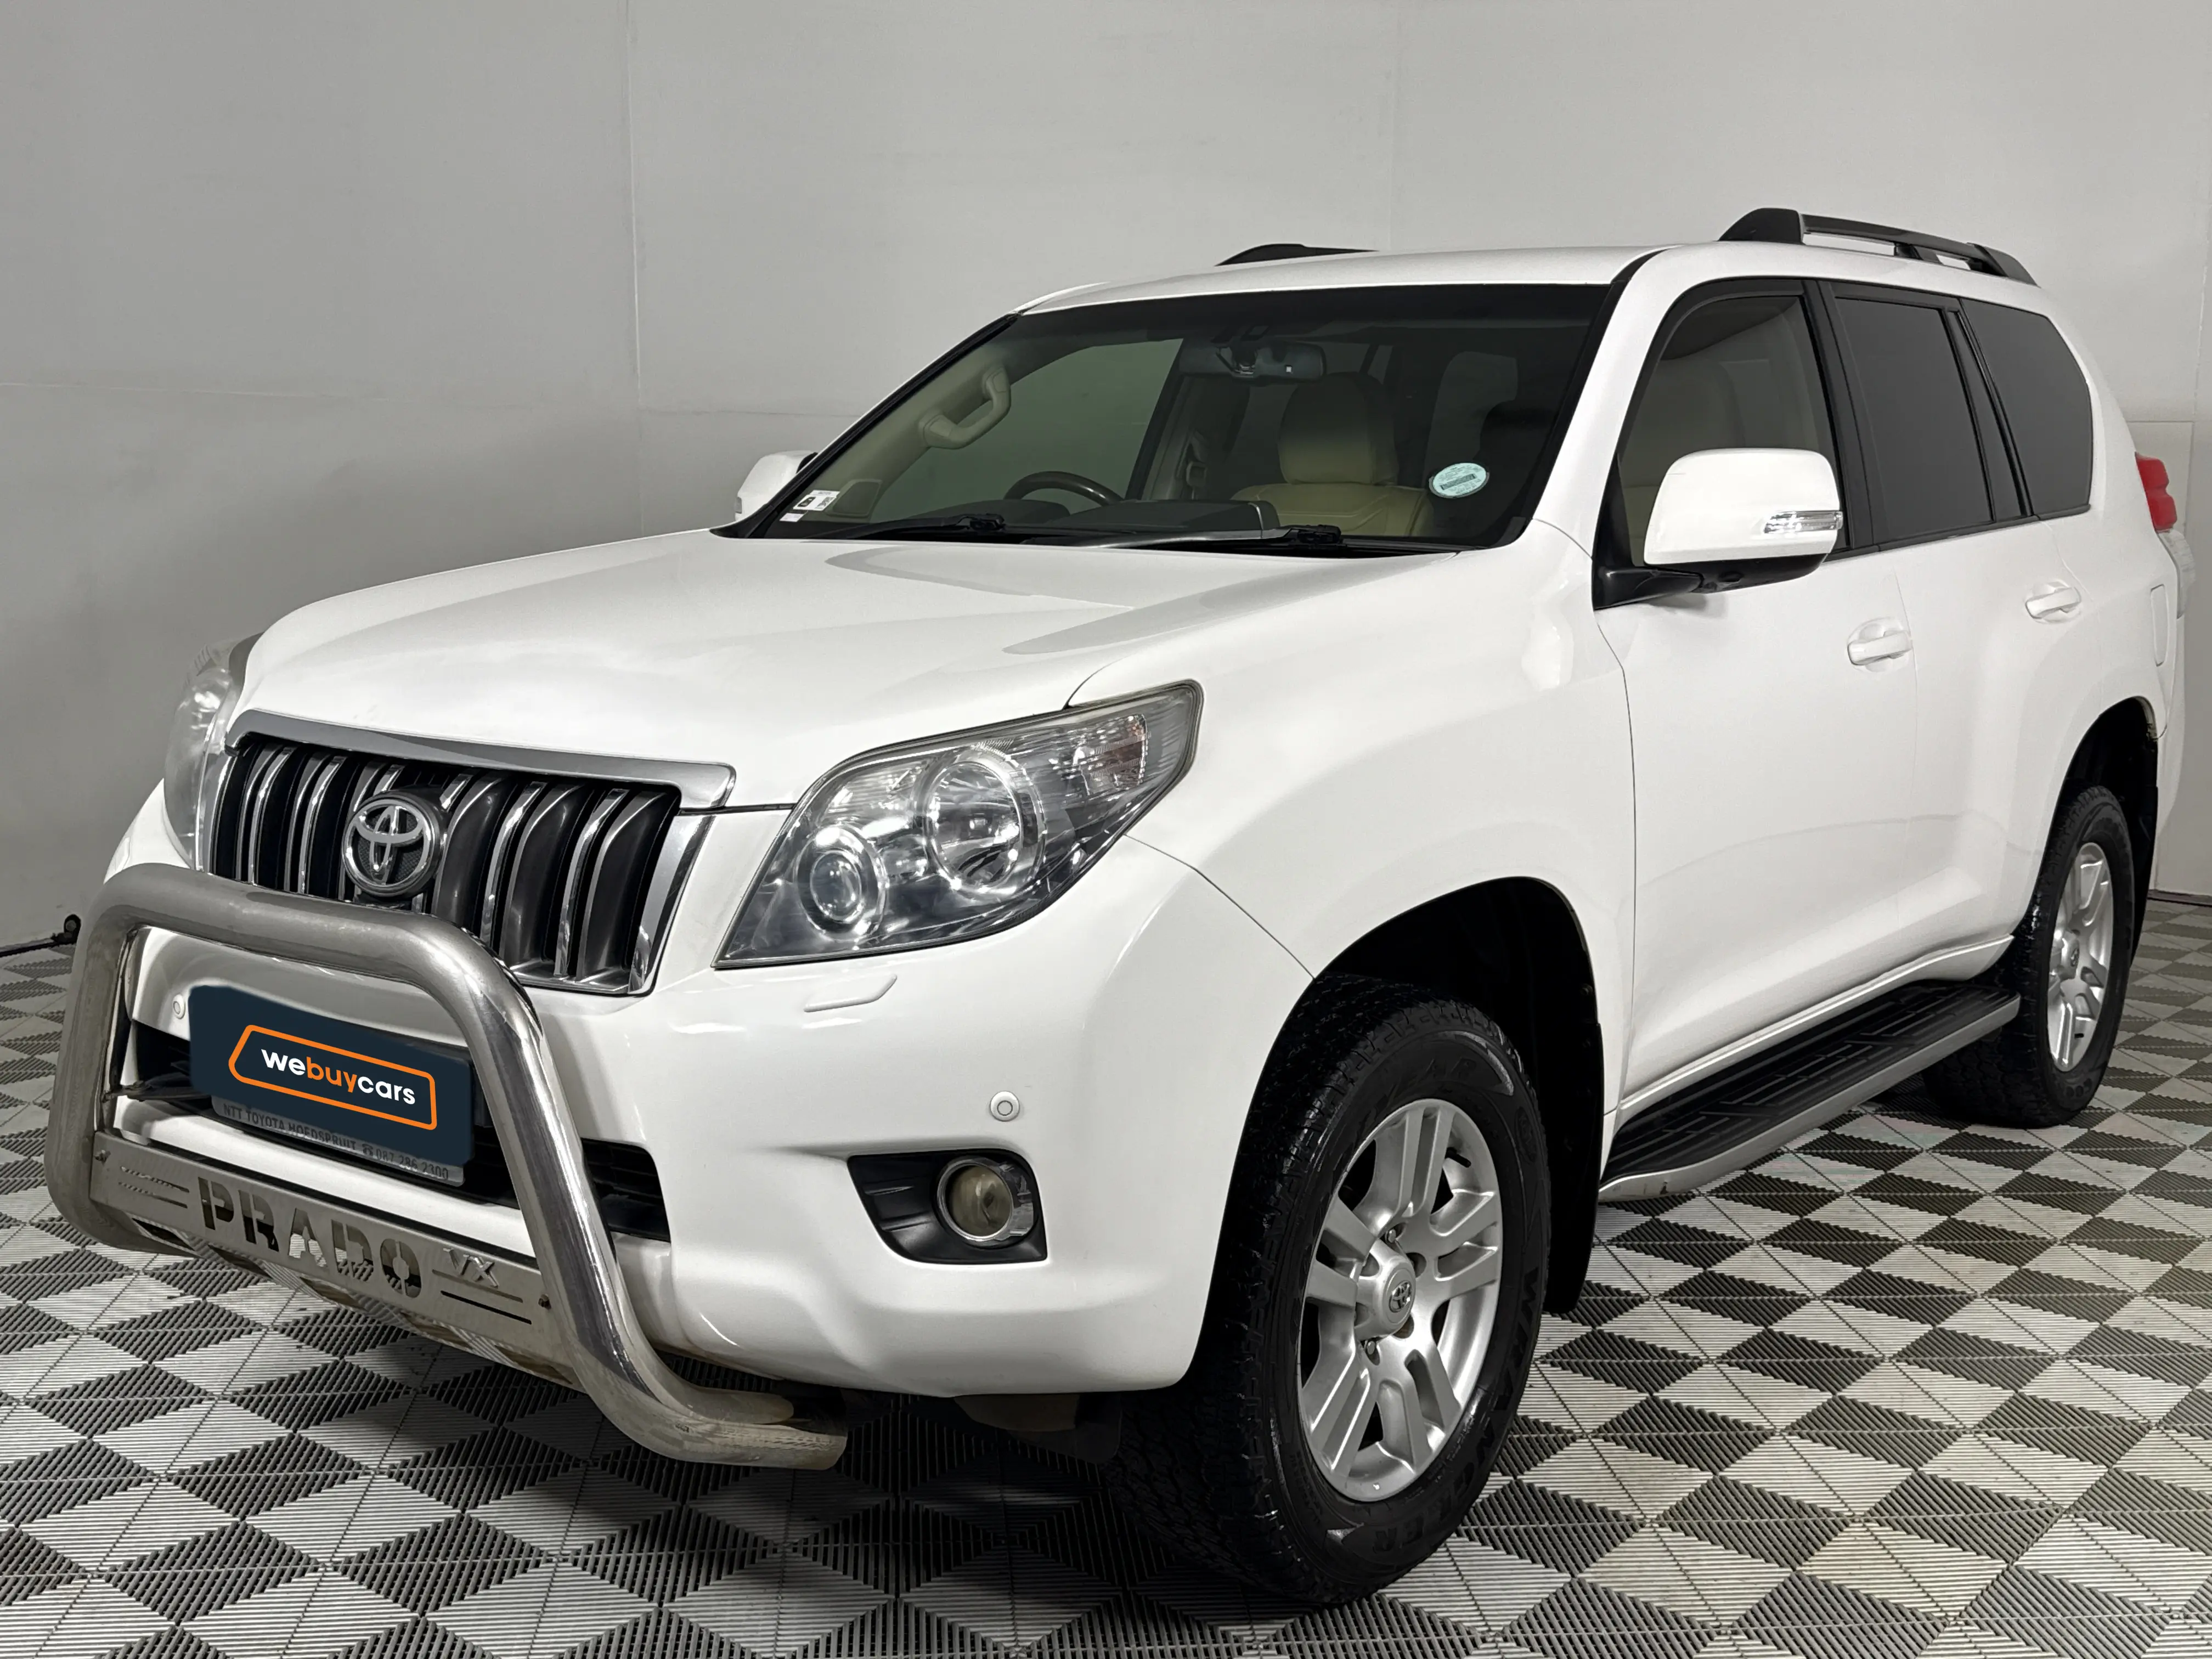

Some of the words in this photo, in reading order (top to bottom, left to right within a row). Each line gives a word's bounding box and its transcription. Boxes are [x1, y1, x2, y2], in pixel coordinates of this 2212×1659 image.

[223, 1103, 243, 1120] NTT
[246, 1110, 285, 1131] TOYOTA
[198, 1176, 425, 1300] PRADO
[443, 1246, 500, 1289] VX
